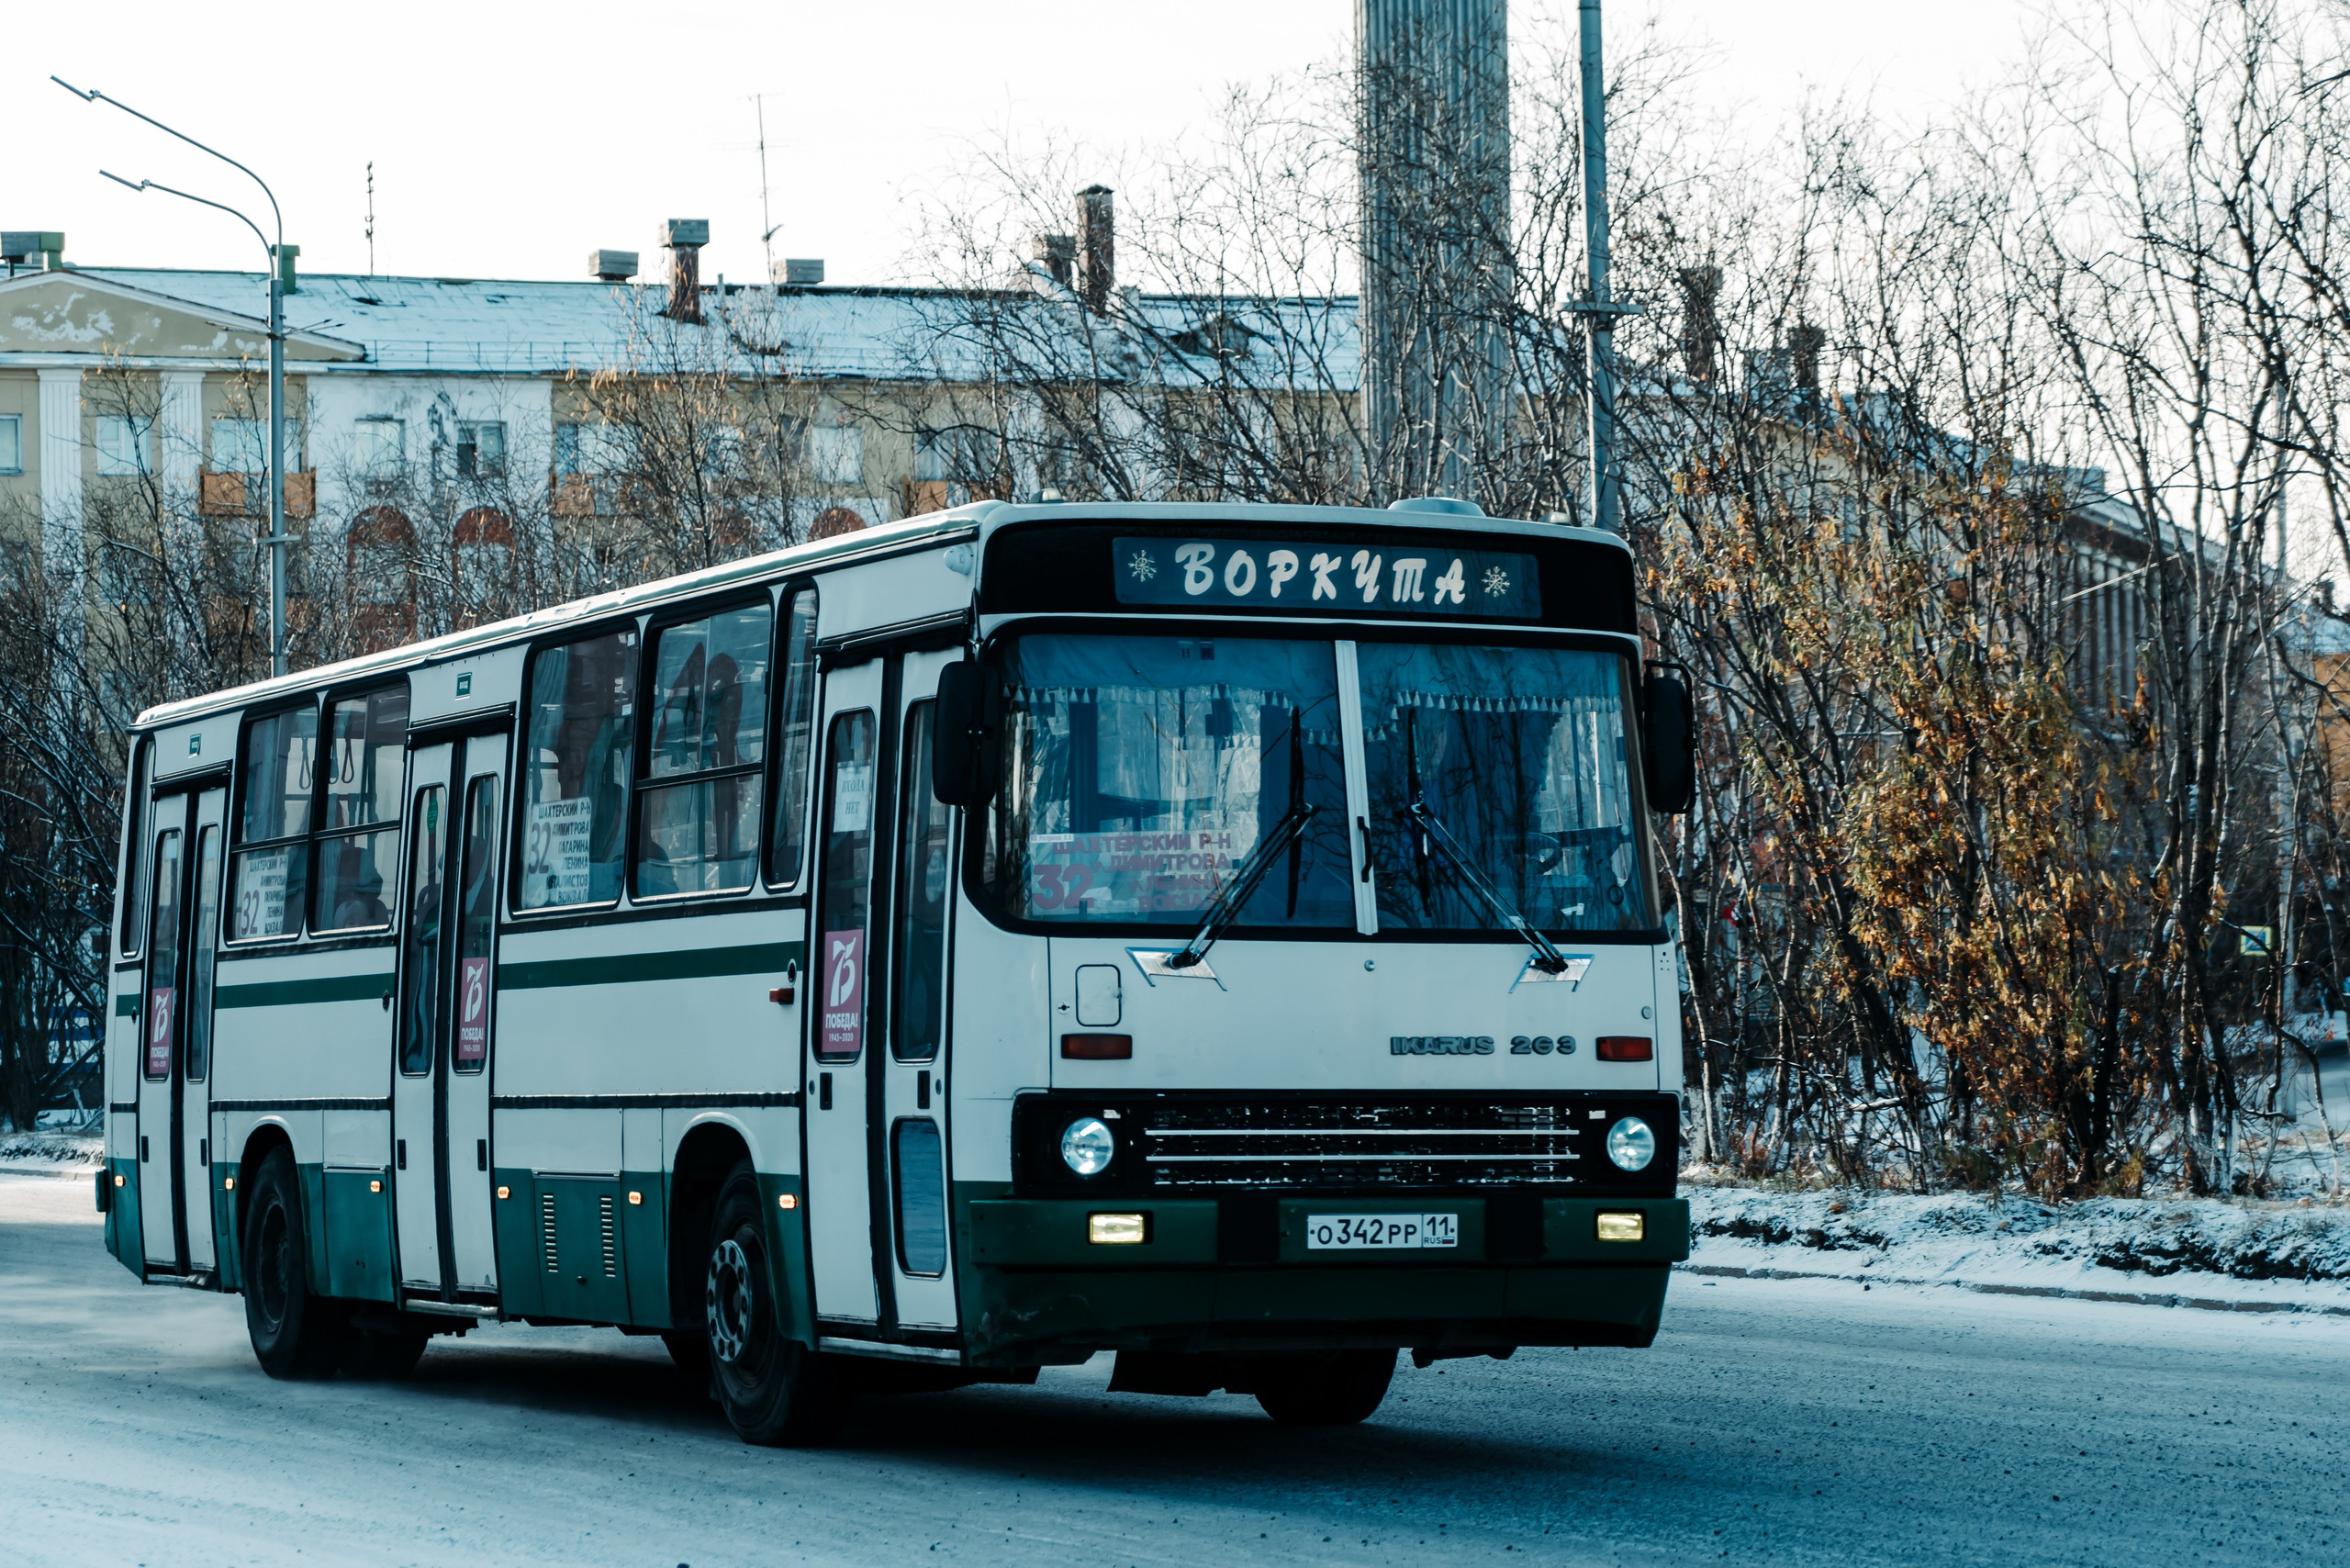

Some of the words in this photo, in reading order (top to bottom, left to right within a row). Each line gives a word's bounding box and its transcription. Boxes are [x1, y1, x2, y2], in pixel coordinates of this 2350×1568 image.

[1175, 543, 1466, 604] ВОРКУТА
[539, 801, 578, 819] ШАХТЕРСКИЙ
[845, 801, 860, 814] НЕТ
[529, 822, 551, 874] 32
[1054, 834, 1192, 855] ШАХТЕРСКИЙ
[1199, 833, 1231, 850] Р-Н
[562, 856, 588, 870] ЛЕНИНА
[1110, 853, 1232, 872] ДИМИТРОВА
[1033, 864, 1094, 910] 32
[241, 890, 260, 935] 32
[830, 936, 856, 1007] 75
[825, 1013, 858, 1030] ПОБЕДА!
[461, 1027, 484, 1042] ПОБЕДА!
[1391, 1036, 1495, 1055] IKARUS
[1510, 1036, 1576, 1055] 263
[1426, 1216, 1449, 1236] 11
